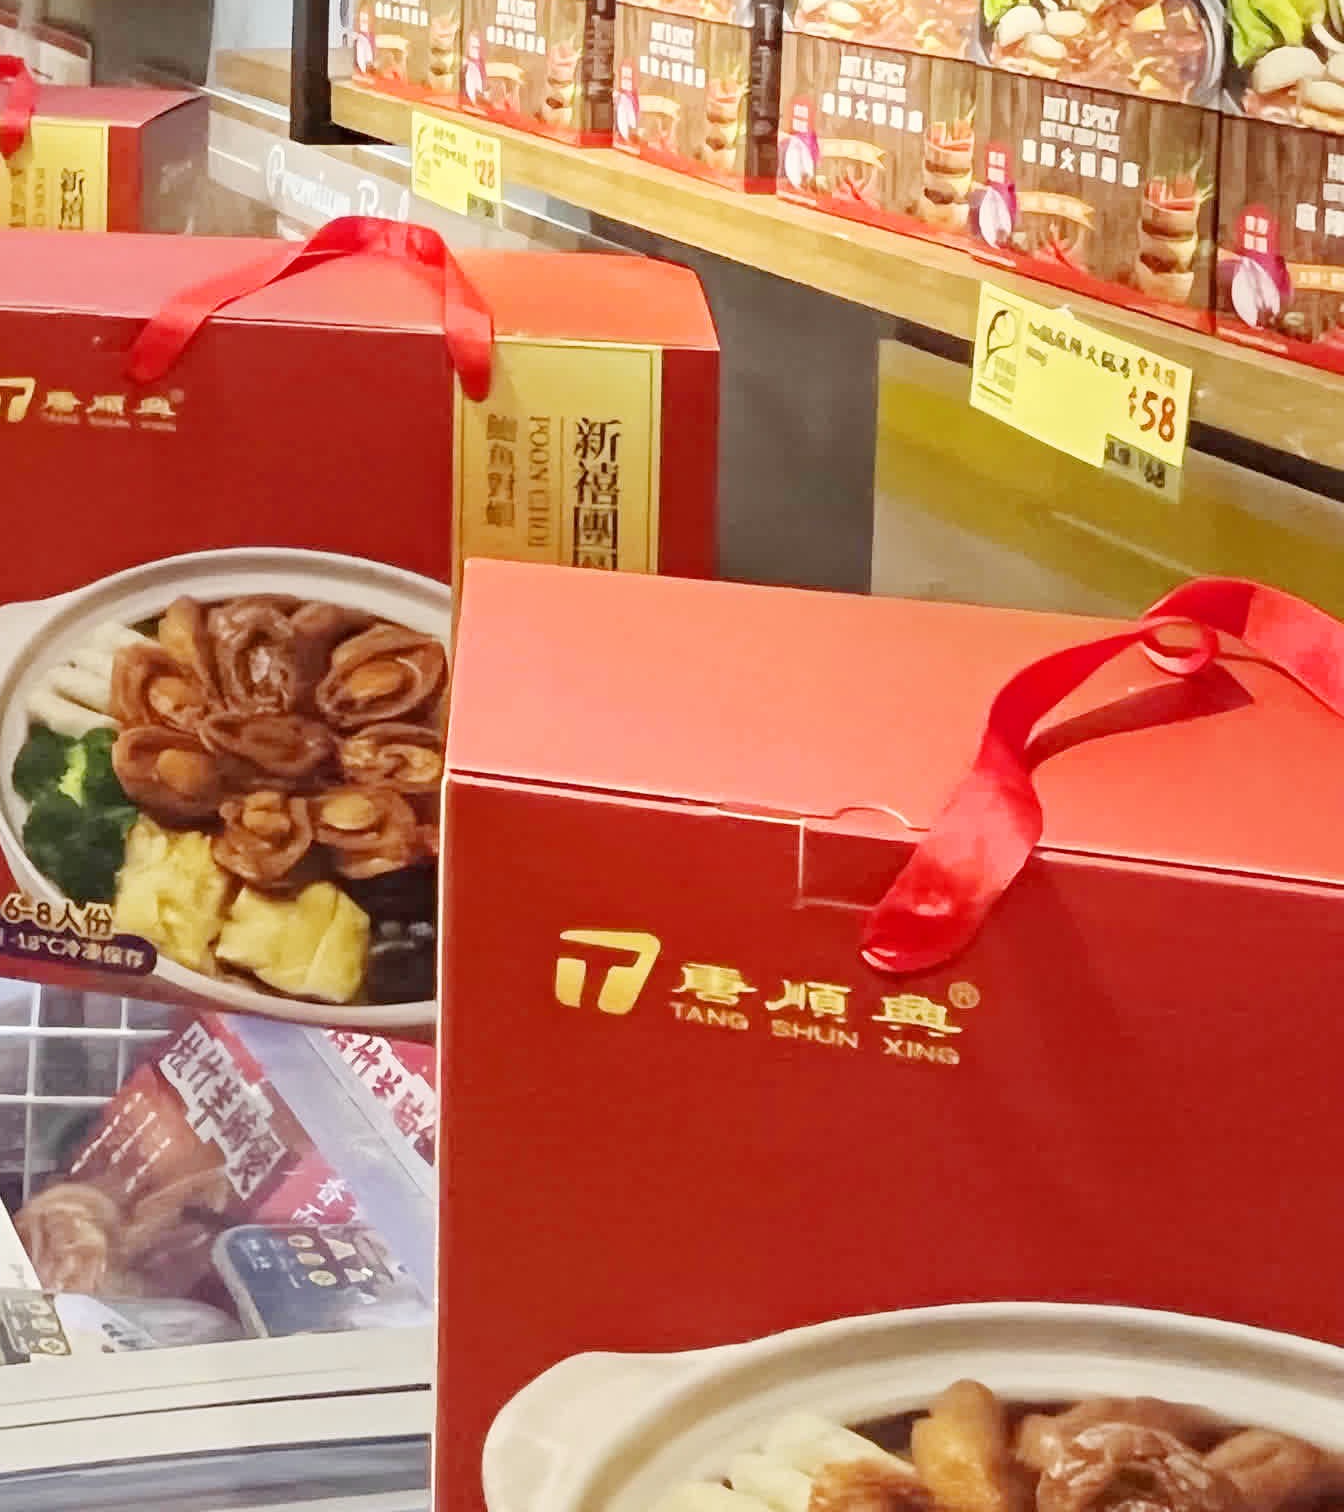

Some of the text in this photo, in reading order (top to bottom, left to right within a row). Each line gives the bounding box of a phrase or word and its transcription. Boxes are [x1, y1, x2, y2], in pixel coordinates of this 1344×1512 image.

[0, 893, 113, 941] 6-8人份
[669, 1001, 961, 1065] TANG SHUN XING
